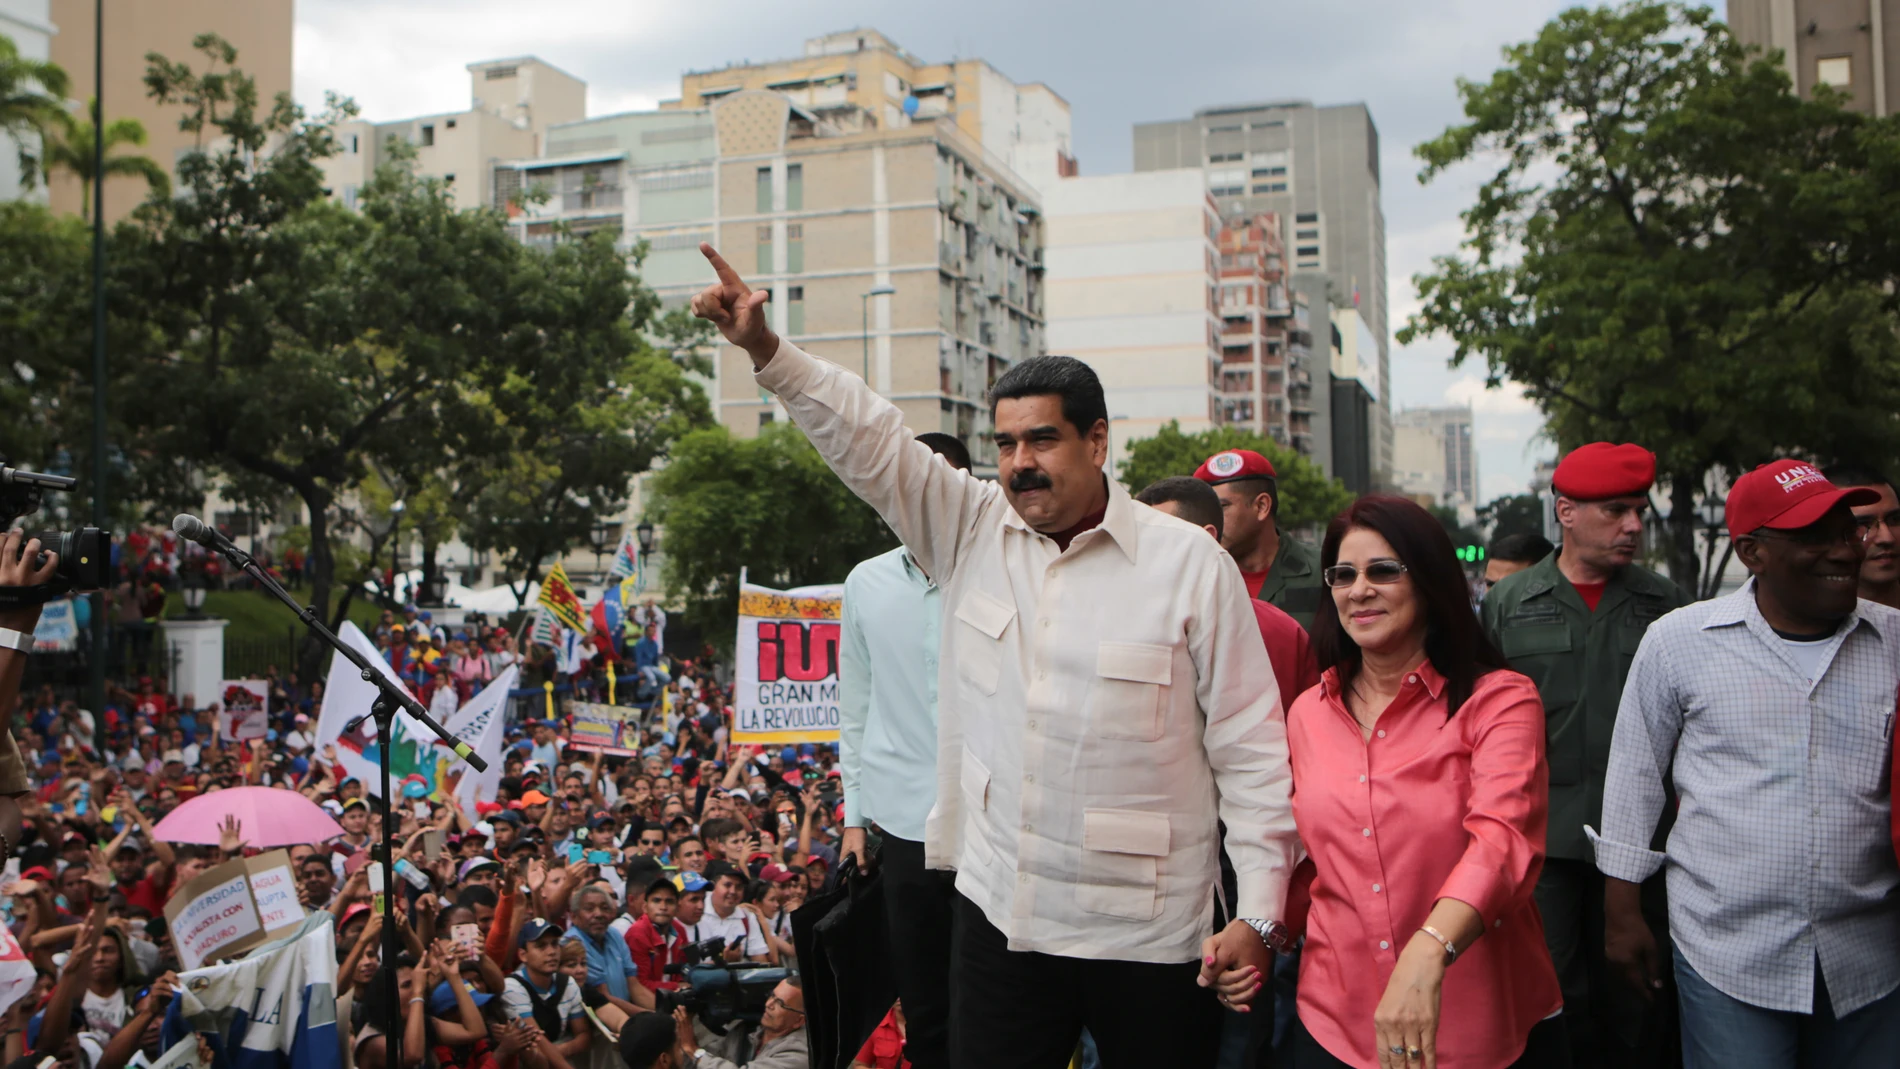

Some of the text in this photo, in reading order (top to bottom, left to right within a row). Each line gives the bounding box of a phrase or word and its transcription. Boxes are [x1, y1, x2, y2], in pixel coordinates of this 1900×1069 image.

[758, 683, 840, 705] GRAN M
[742, 706, 840, 729] LA REVOLUCIO
[222, 902, 244, 918] CON
[195, 925, 238, 956] MADURO
[248, 987, 284, 1025] LA
